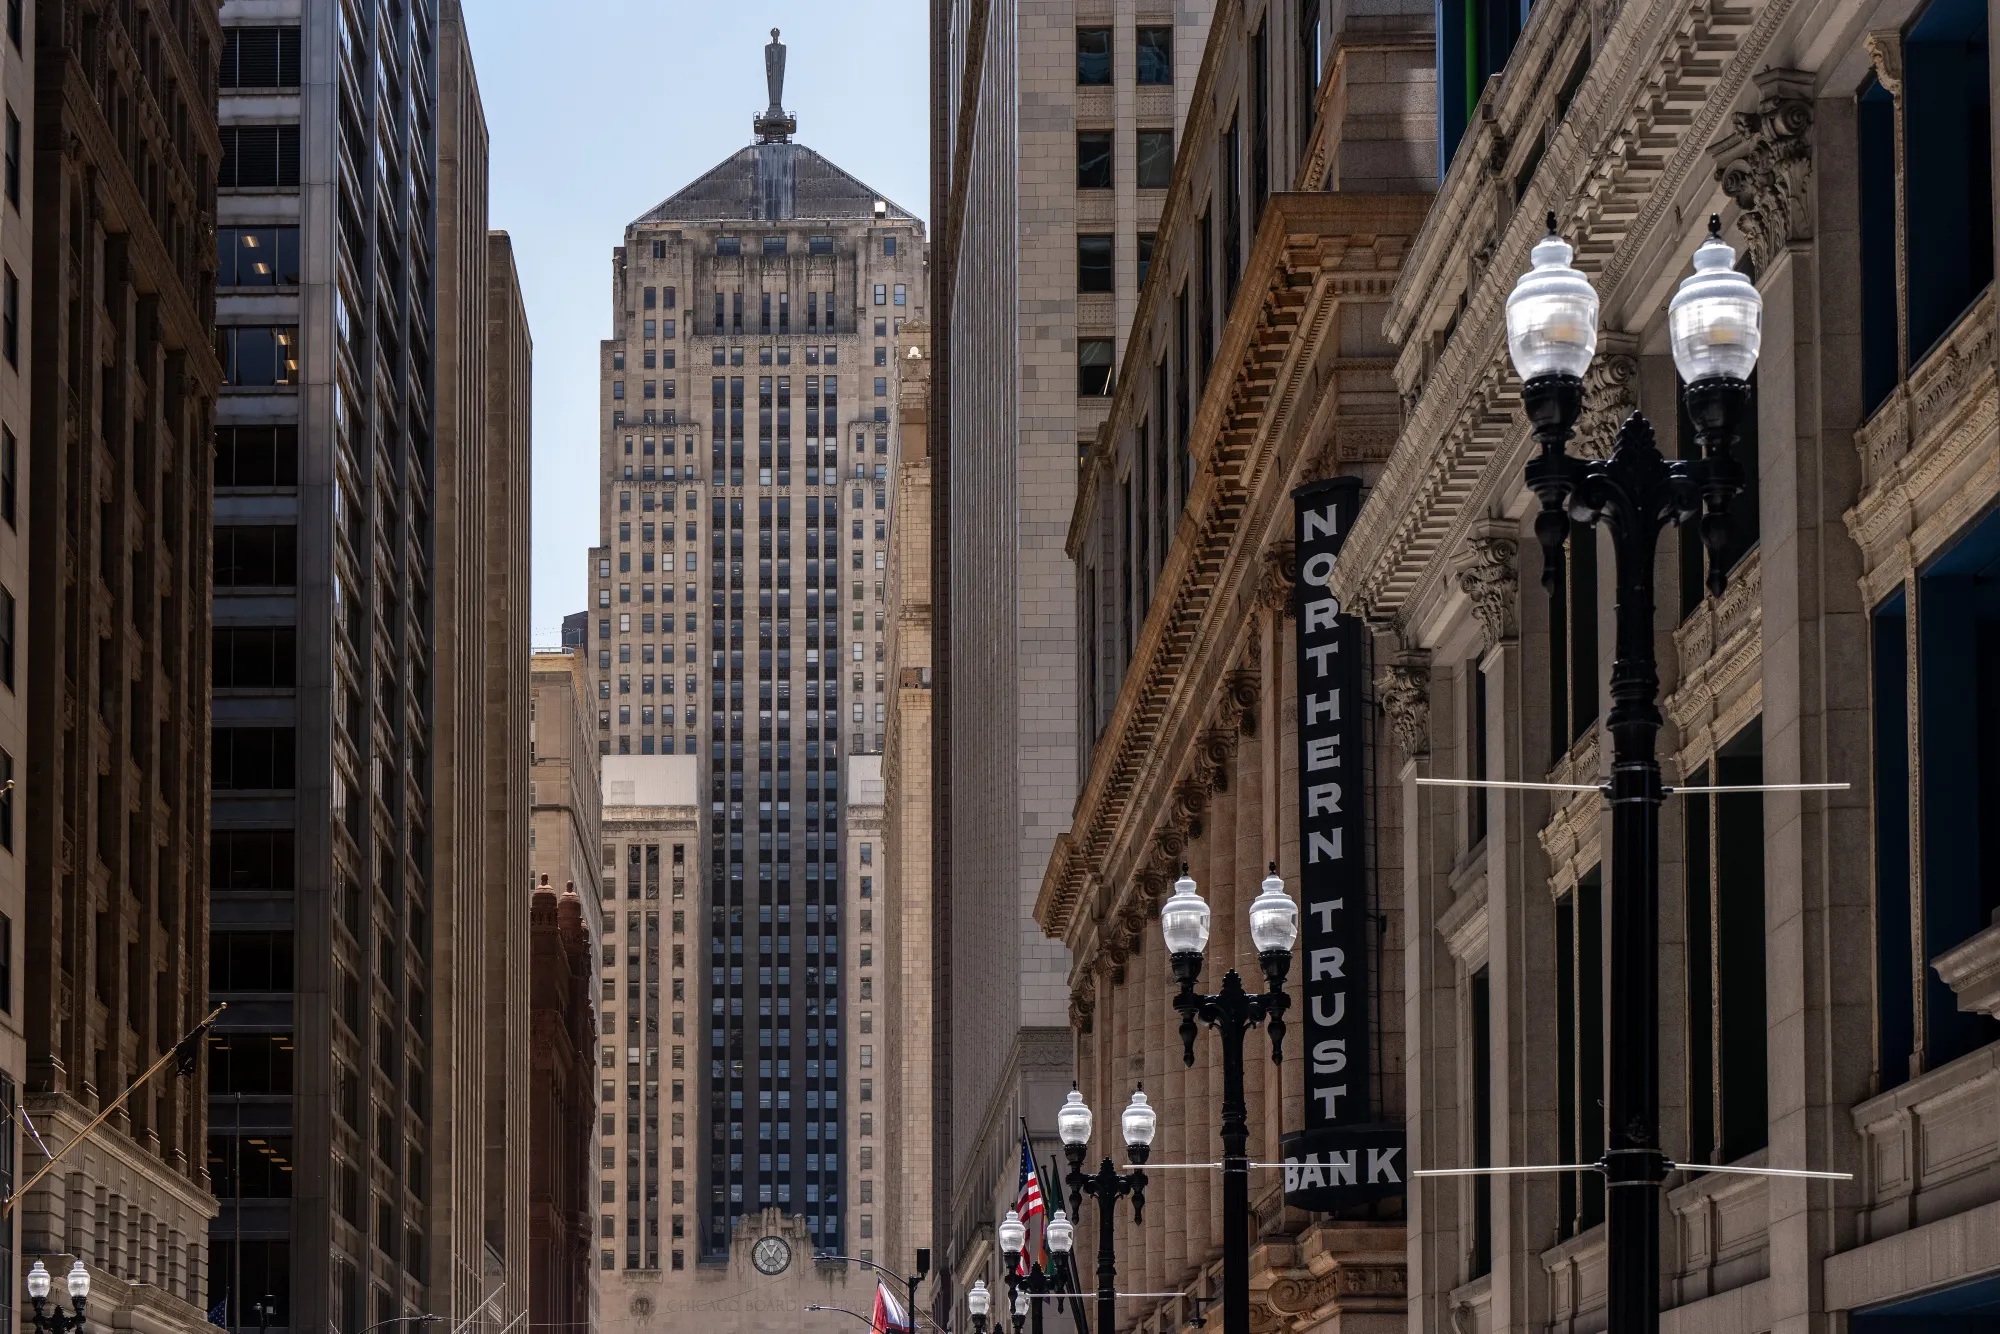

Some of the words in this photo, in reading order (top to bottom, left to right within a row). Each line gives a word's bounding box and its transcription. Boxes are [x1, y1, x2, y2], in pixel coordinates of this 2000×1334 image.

[1303, 504, 1343, 864] NORTHERN
[1310, 897, 1347, 1119] TRUST
[1284, 1148, 1402, 1193] BANK
[667, 1299, 742, 1312] CHICAGO
[745, 1299, 797, 1312] BOARD
[831, 1299, 876, 1312] TRAD
